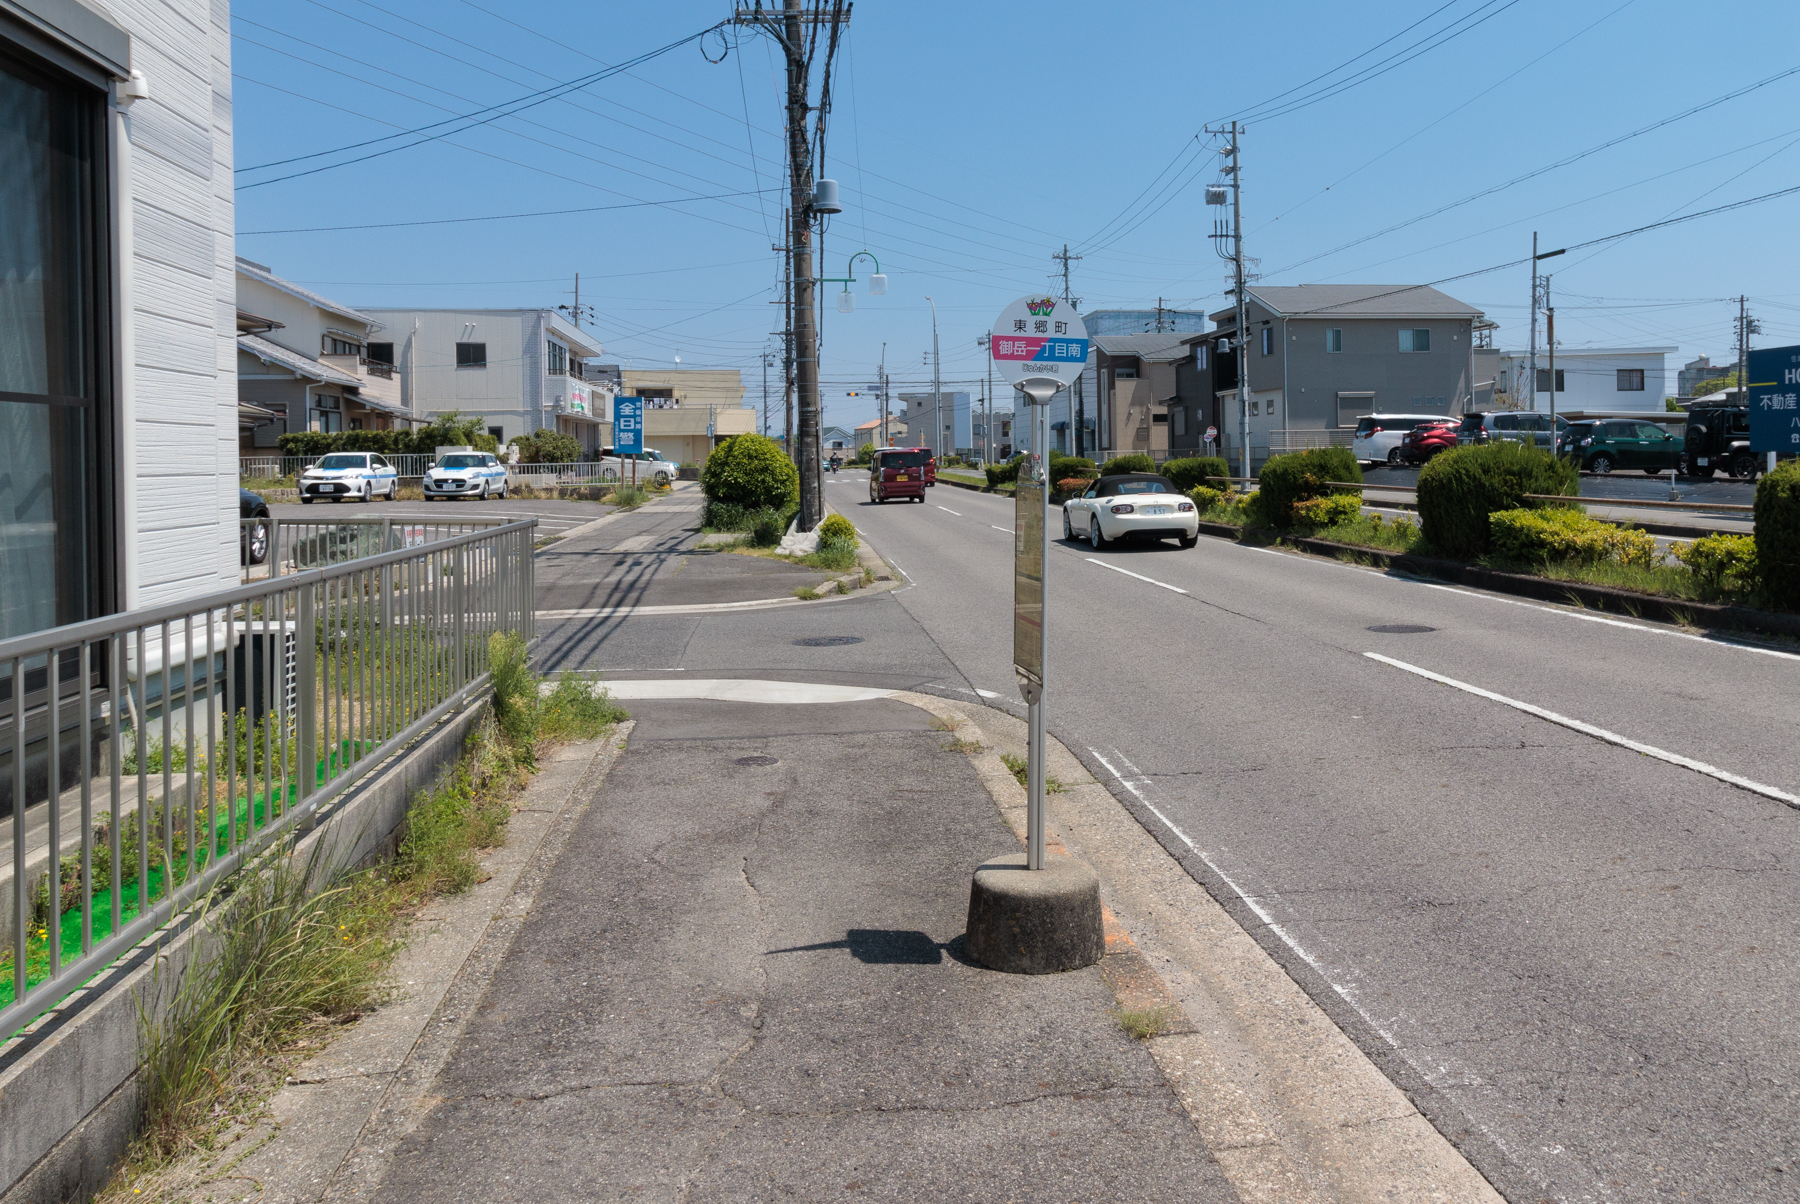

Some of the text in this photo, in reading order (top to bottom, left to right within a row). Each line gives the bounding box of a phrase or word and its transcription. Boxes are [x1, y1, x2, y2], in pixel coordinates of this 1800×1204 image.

[1013, 319, 1068, 335] 東郷町
[999, 341, 1081, 358] 御岳一丁目南
[1760, 392, 1797, 411] 不動産
[619, 402, 635, 445] 全日警
